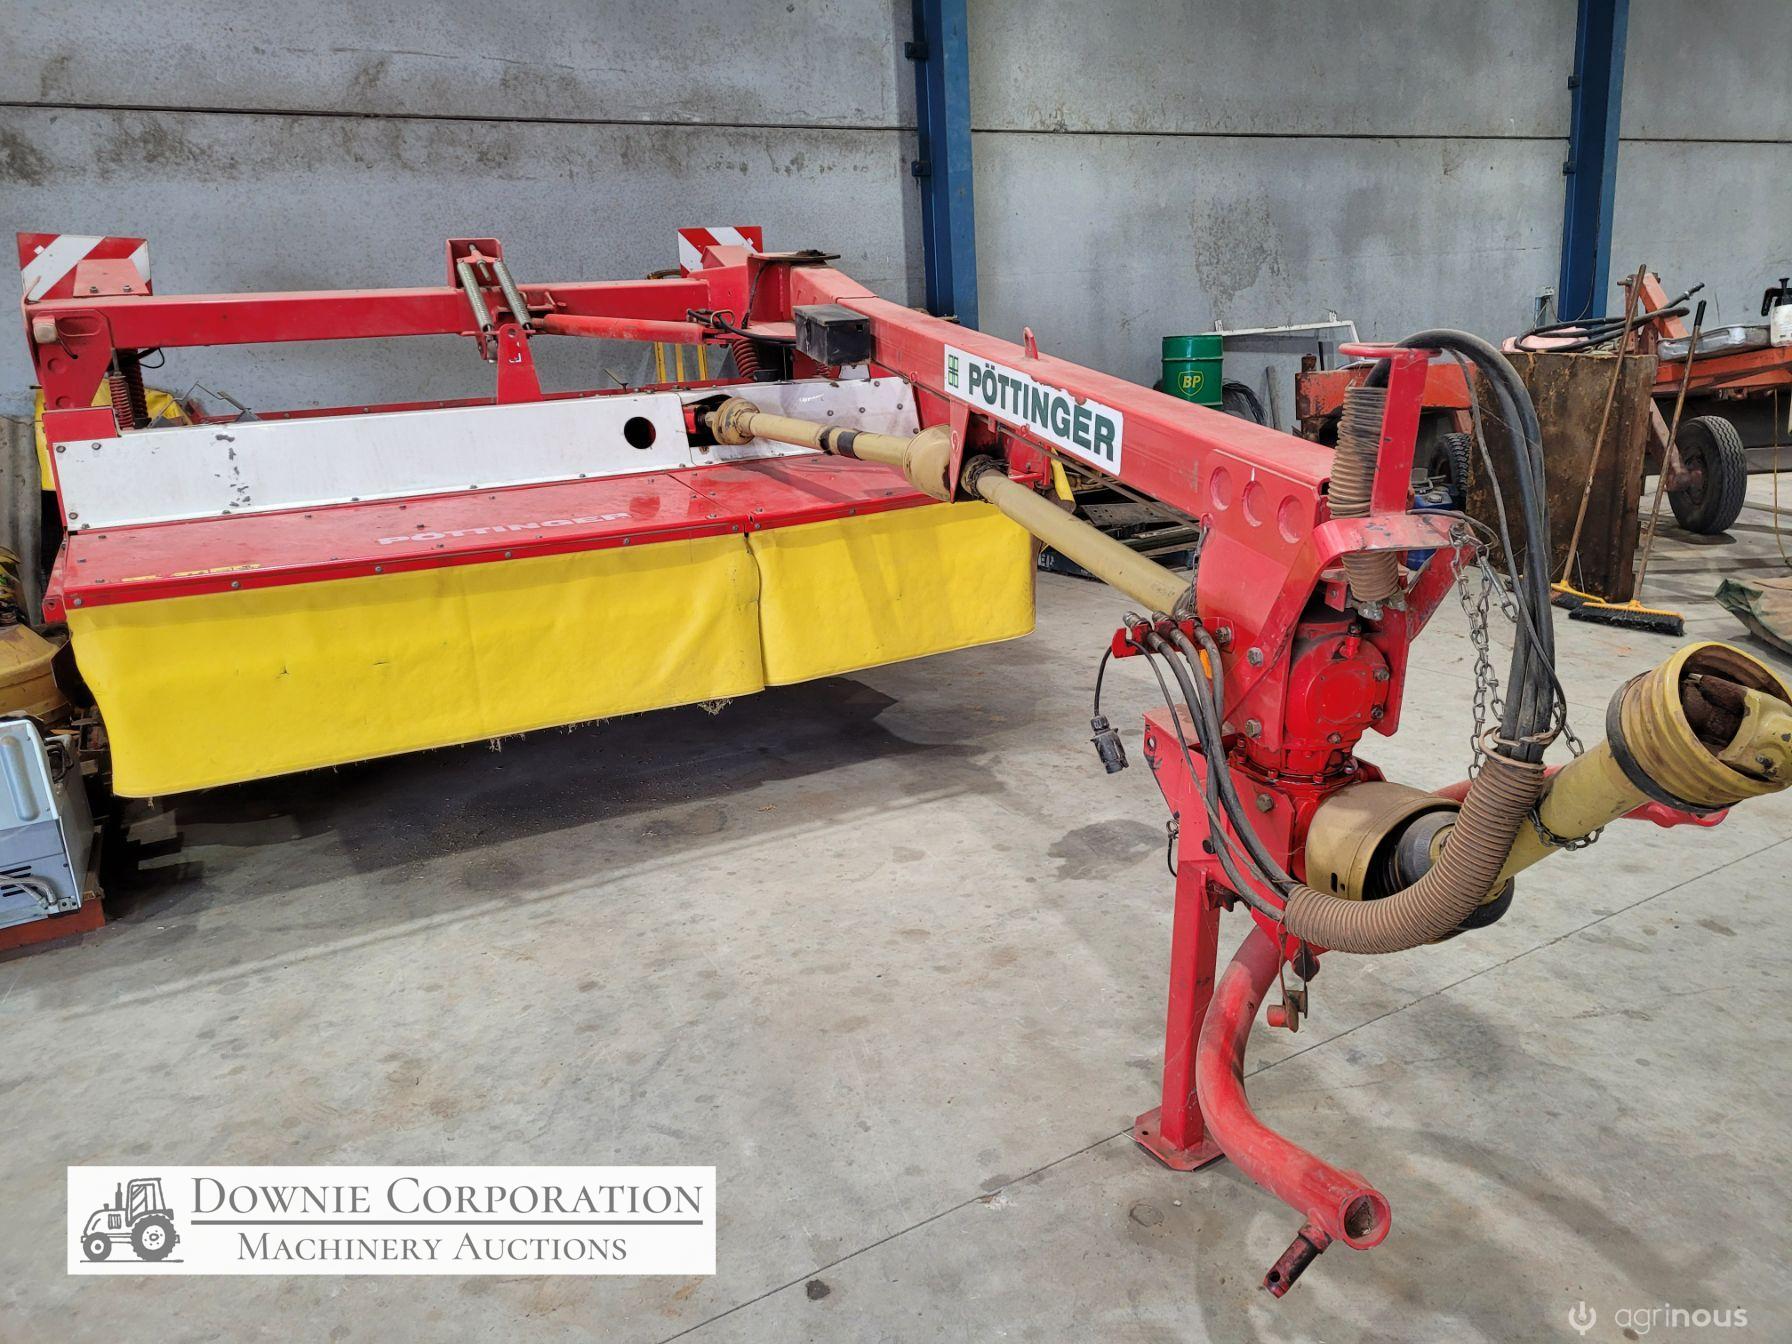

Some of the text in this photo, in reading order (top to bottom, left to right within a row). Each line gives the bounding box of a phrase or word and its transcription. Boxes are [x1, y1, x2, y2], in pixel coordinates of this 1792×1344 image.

[1183, 375, 1201, 389] BP
[968, 362, 1116, 462] PÖTTINGER
[377, 511, 634, 545] PÖTTINGER
